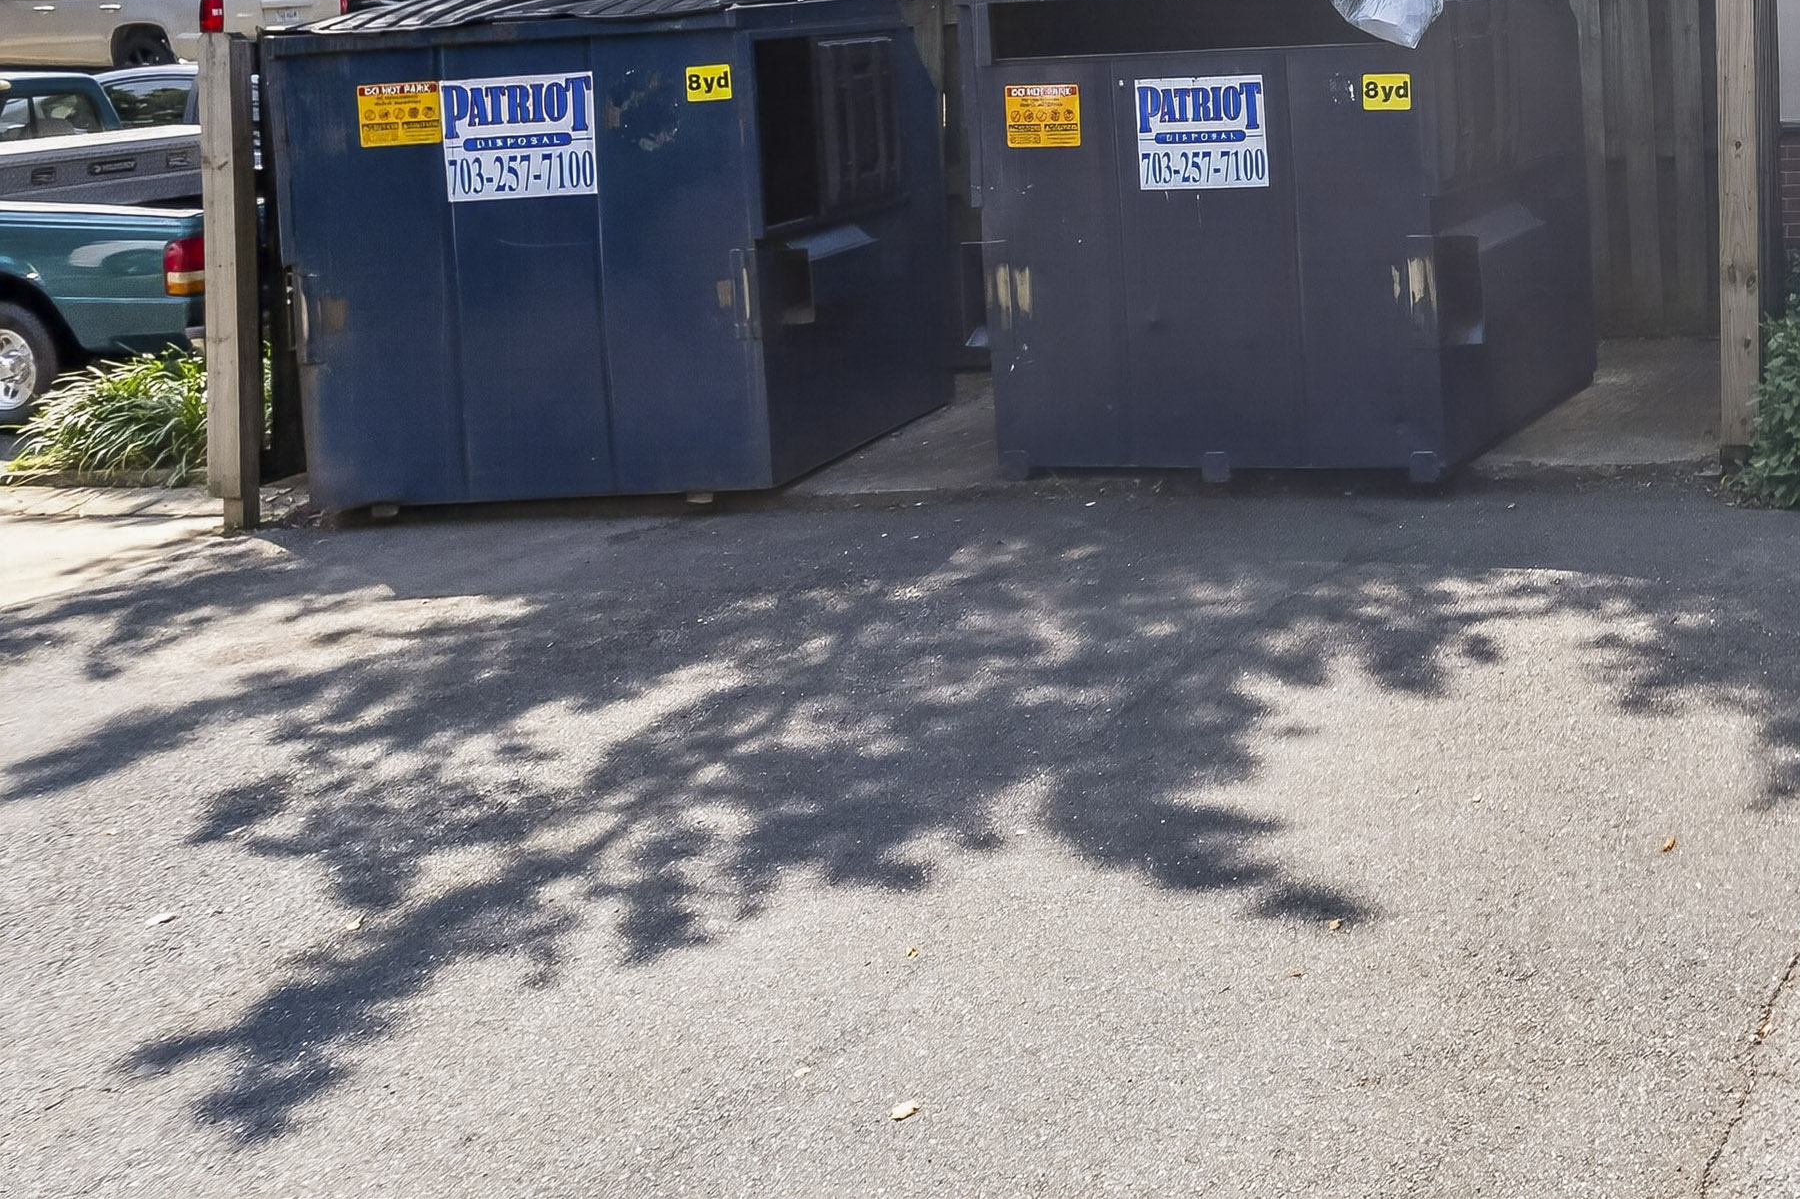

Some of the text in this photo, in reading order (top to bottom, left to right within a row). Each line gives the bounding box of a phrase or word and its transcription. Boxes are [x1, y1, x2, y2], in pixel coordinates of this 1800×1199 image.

[688, 70, 729, 94] 8yd
[1364, 81, 1408, 103] 8yd
[442, 76, 592, 139] PATRIOT
[1137, 82, 1262, 133] PATRIOT
[476, 137, 561, 150] DISPOSAL
[448, 150, 595, 195] 703-257-7100
[1141, 149, 1266, 185] 703-257-7100
